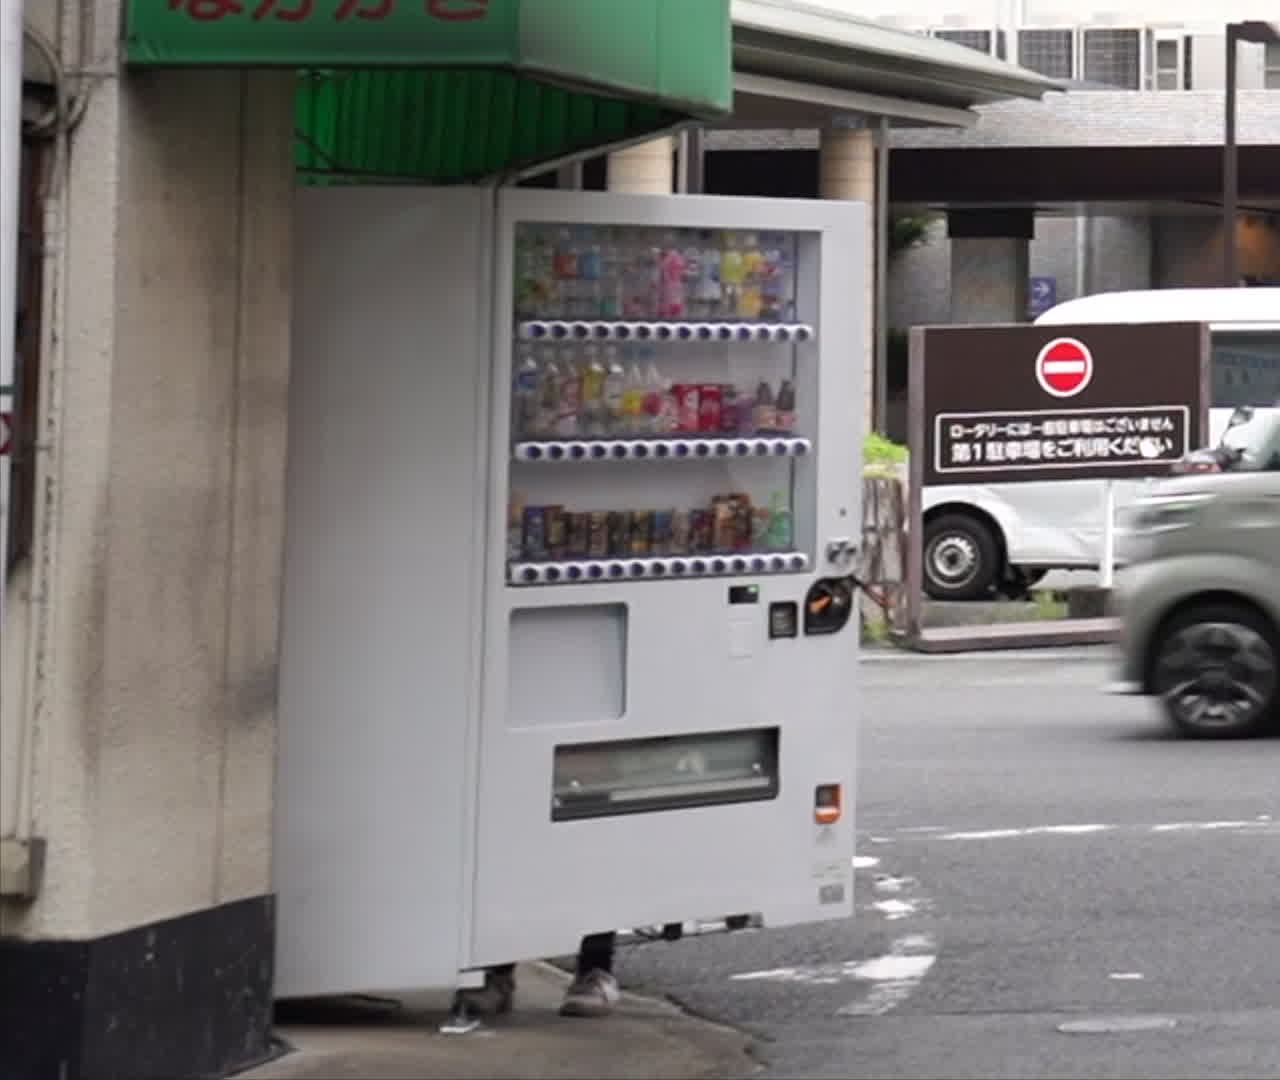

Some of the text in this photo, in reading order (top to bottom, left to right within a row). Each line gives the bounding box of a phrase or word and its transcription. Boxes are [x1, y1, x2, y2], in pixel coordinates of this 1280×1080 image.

[951, 434, 1174, 463] 第1駐車場をご利用くだい
